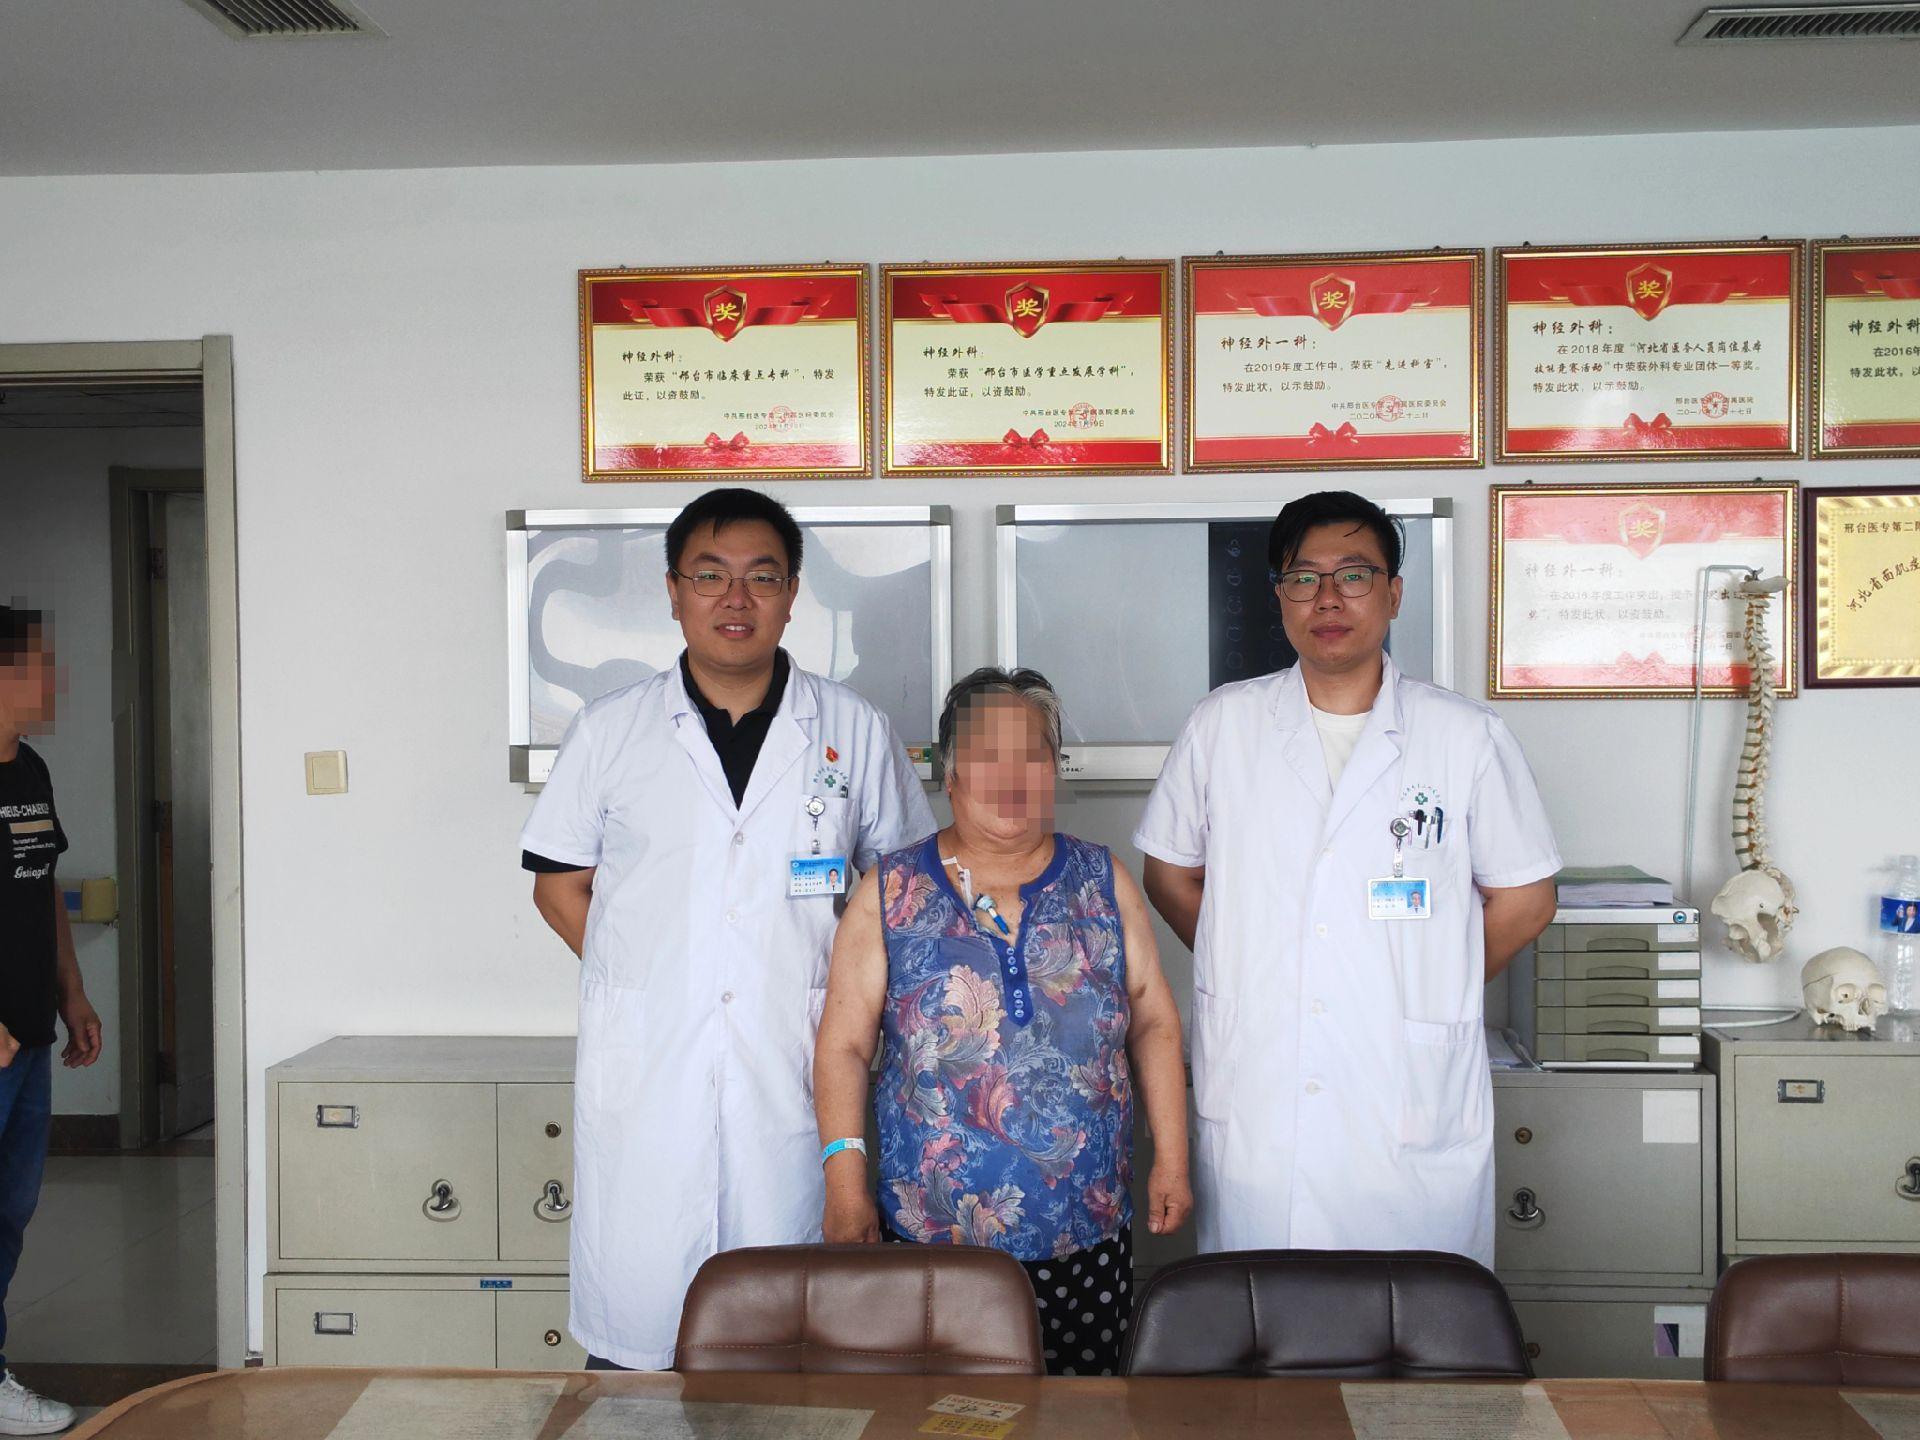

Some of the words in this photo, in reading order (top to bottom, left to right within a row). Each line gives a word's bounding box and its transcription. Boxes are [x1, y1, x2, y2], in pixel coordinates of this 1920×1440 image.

[1636, 280, 1663, 299] 奖
[1014, 298, 1041, 318] 奖
[1320, 291, 1347, 310] 奖
[712, 302, 739, 321] 奖
[1628, 520, 1656, 537] 奖
